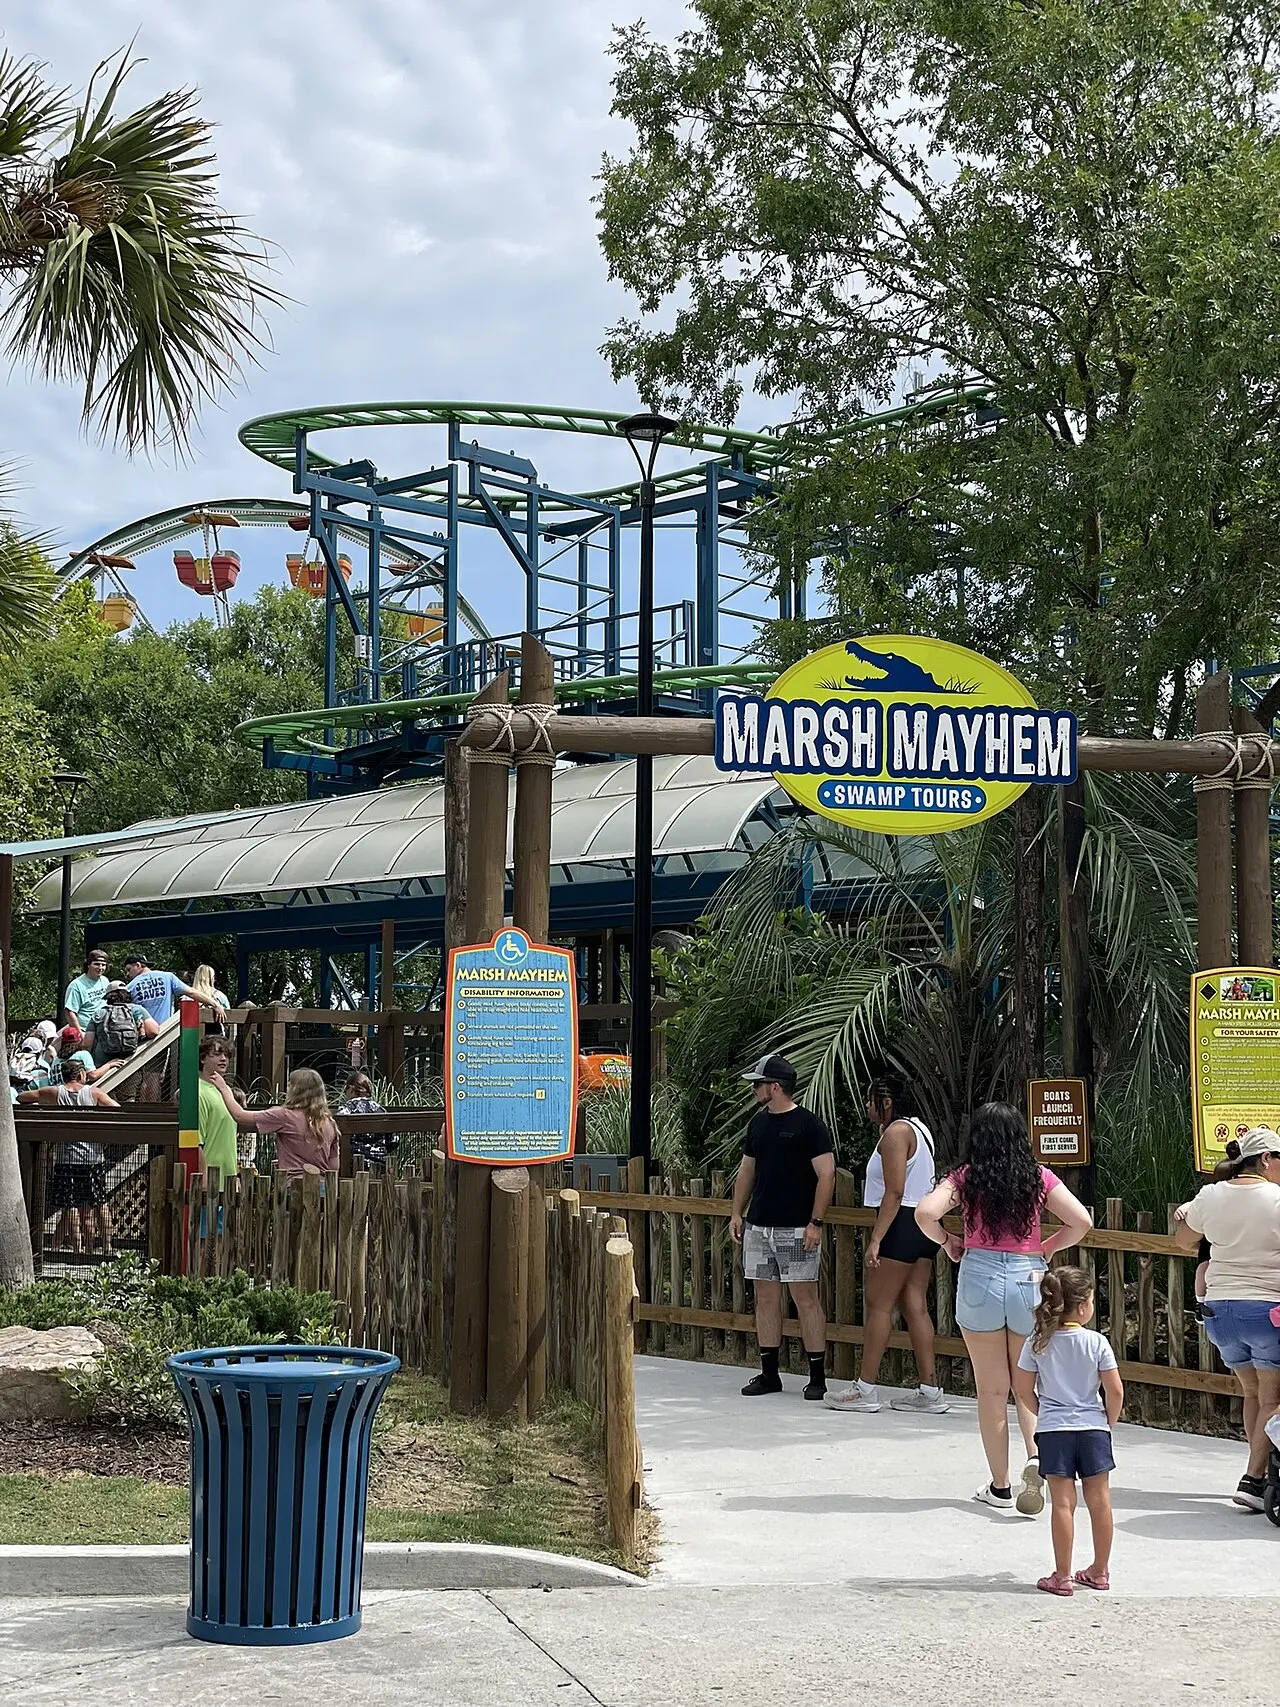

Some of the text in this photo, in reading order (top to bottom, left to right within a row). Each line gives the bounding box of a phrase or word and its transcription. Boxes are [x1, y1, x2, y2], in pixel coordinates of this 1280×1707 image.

[723, 701, 1071, 777] MARSH MAYHEM
[834, 784, 972, 809] SWAMP TOURS
[456, 968, 568, 982] MARSH MAYHEM
[135, 977, 164, 992] JESUS
[137, 987, 166, 1001] SAVES
[464, 989, 561, 997] DISABILITY INFORMATION
[1199, 1008, 1280, 1020] MARSH MAYH
[1044, 1091, 1070, 1101] BOATS
[1042, 1104, 1073, 1113] LAUNCH
[1034, 1116, 1082, 1126] FREQUENTLY
